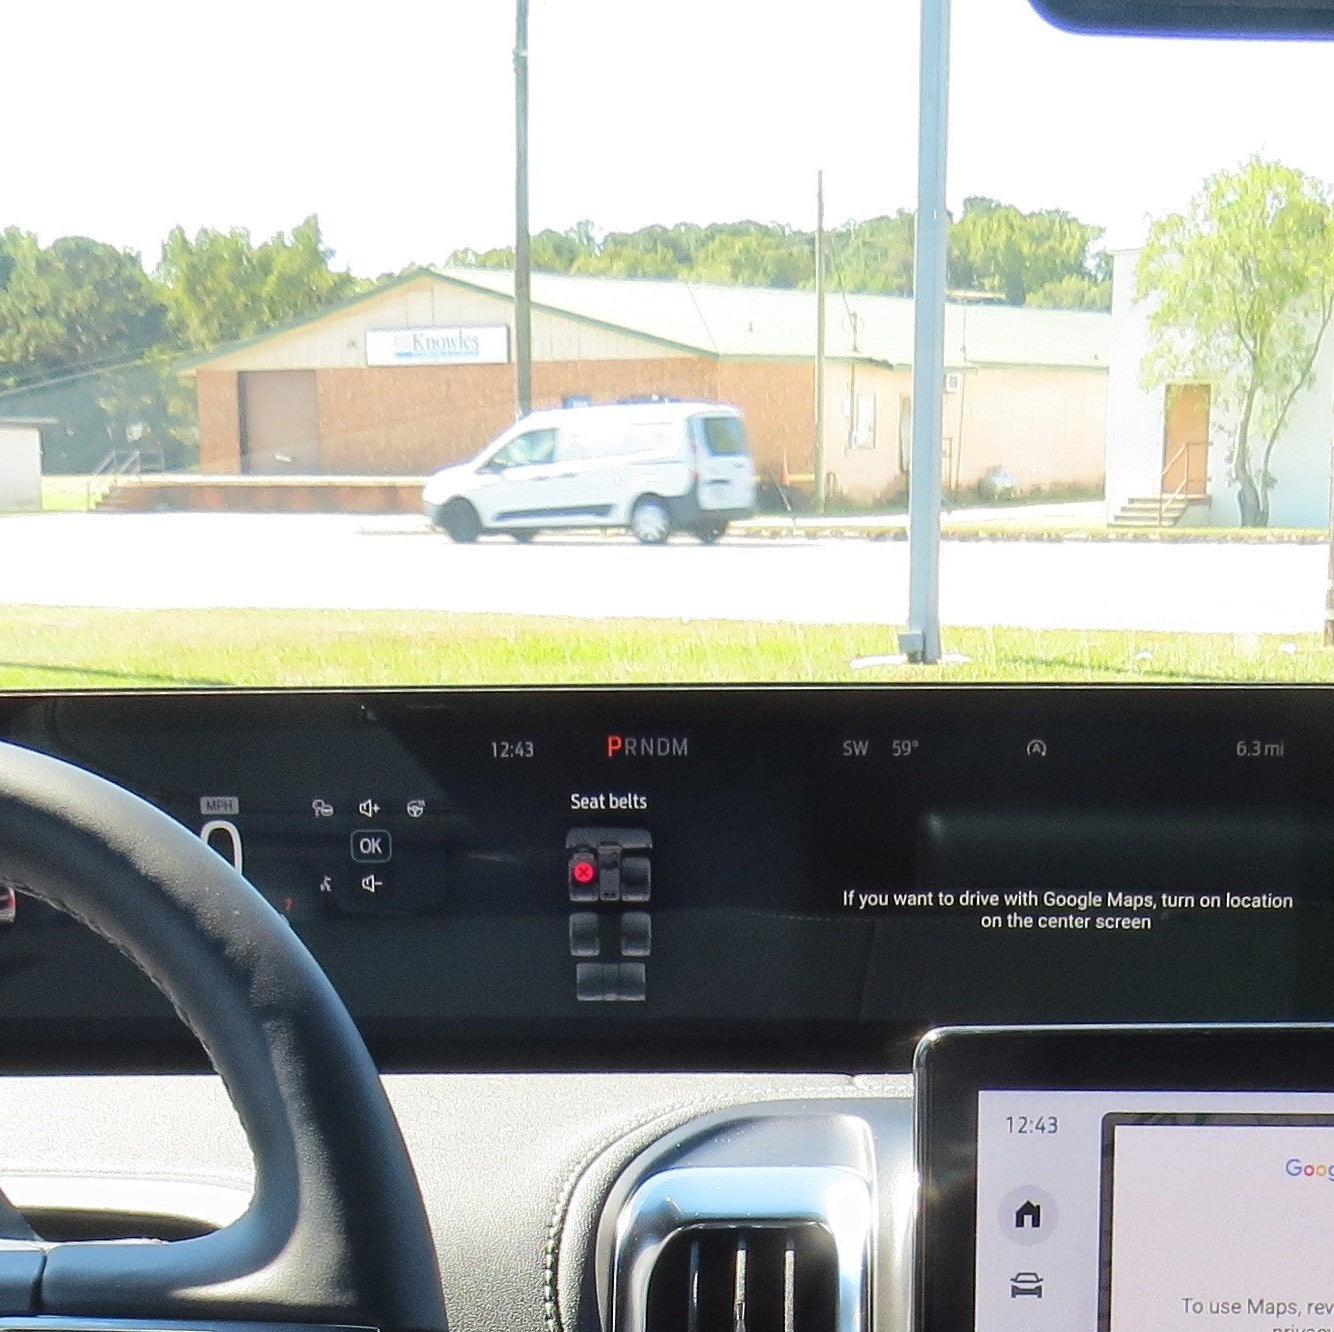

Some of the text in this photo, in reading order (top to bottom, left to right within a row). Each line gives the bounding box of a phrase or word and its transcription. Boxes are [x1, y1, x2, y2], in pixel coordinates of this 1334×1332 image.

[412, 330, 480, 351] Knowles
[490, 740, 535, 758] 12:43
[842, 739, 869, 757] SW
[892, 739, 920, 757] 59°
[1236, 740, 1285, 757] 6.3 mi
[205, 800, 234, 813] MPH
[570, 792, 648, 810] Seat belts
[359, 837, 383, 855] OK
[843, 889, 1293, 911] If you want to drive with Google Maps, turn on location
[981, 911, 1151, 930] on the center screen
[1005, 1115, 1059, 1136] 12:43
[1180, 1297, 1204, 1316] To
[1208, 1301, 1242, 1316] use
[1246, 1297, 1303, 1320] Maps,
